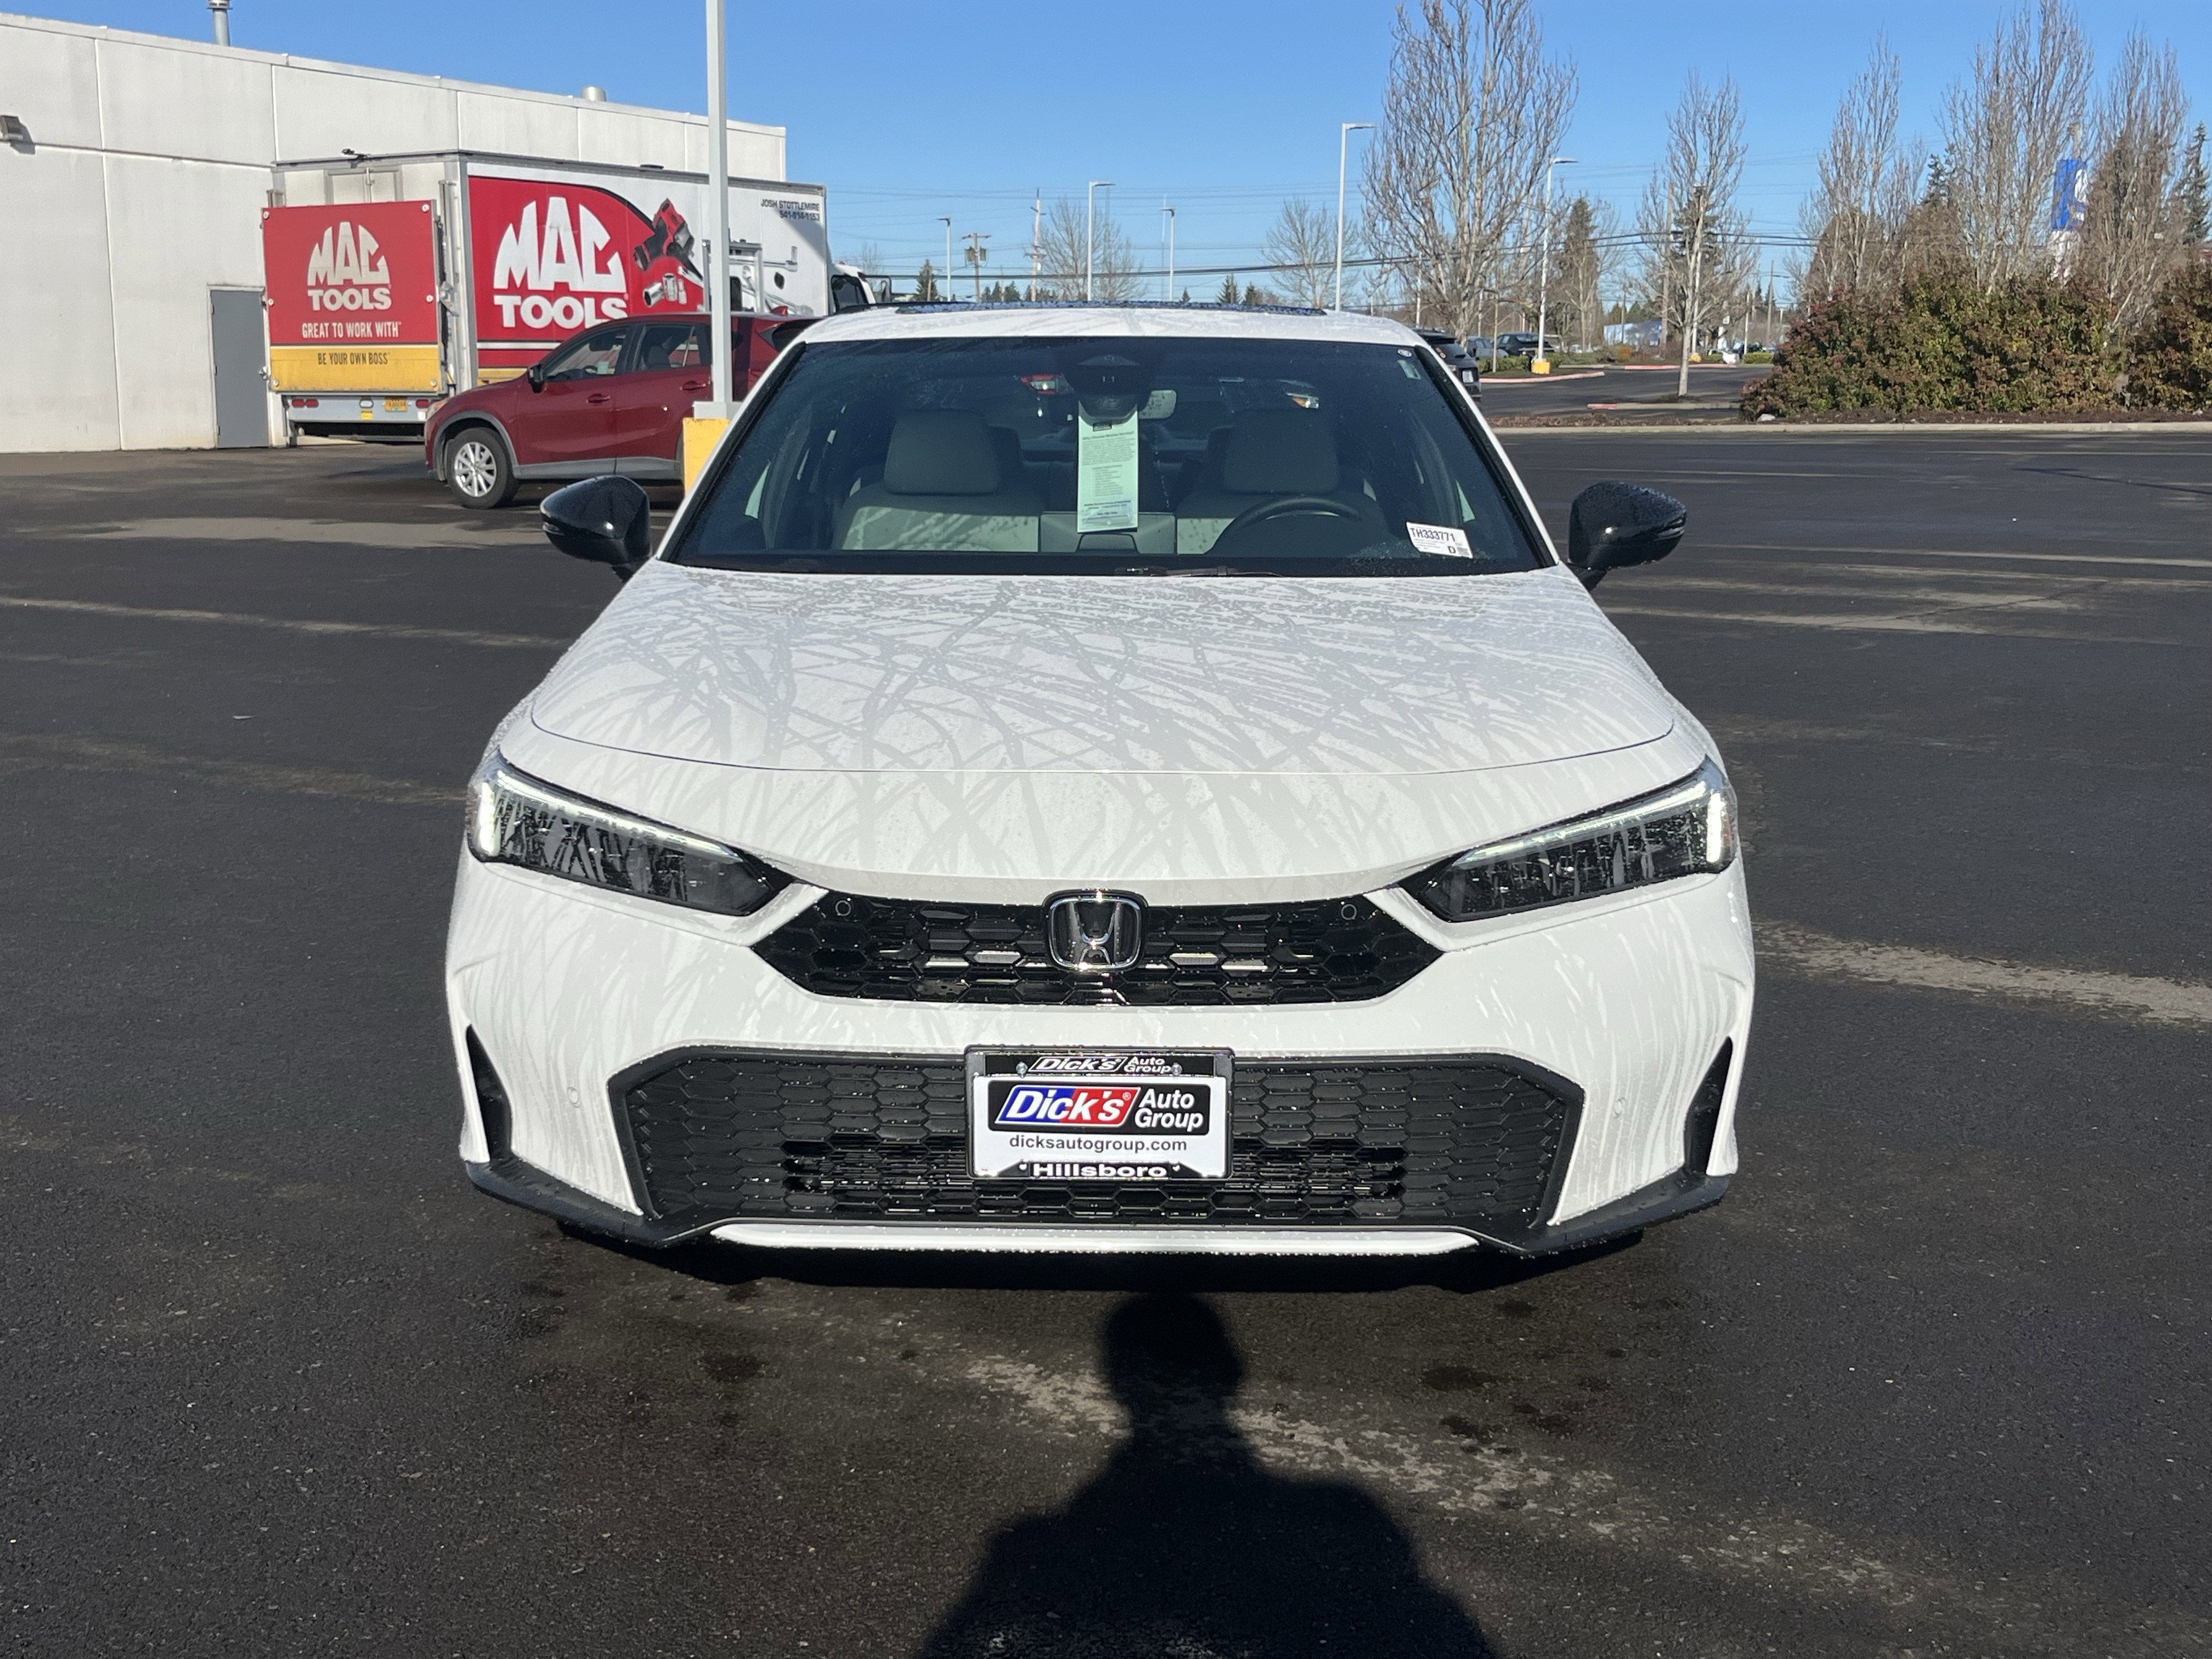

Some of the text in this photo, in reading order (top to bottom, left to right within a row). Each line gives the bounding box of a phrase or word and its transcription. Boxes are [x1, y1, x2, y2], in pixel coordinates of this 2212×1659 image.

[760, 199, 777, 208] JOSH
[493, 196, 627, 293] MAC
[307, 221, 390, 286] MAC
[307, 287, 392, 311] TOOLS
[493, 295, 628, 329] TOOLS
[302, 321, 399, 338] GREAT TO WORK WITH
[318, 353, 388, 365] BE YOUR OWN BOSS
[1409, 528, 1455, 543] TH333771
[1037, 1058, 1121, 1071] Dick's
[1124, 1064, 1172, 1074] Group
[1128, 1057, 1165, 1066] Auto
[1005, 1090, 1126, 1121] Dick's
[1138, 1088, 1195, 1109] Auto
[1135, 1108, 1204, 1132] Group
[1009, 1135, 1187, 1153] dicksautogroup.com
[1032, 1163, 1168, 1178] Hillsboro
